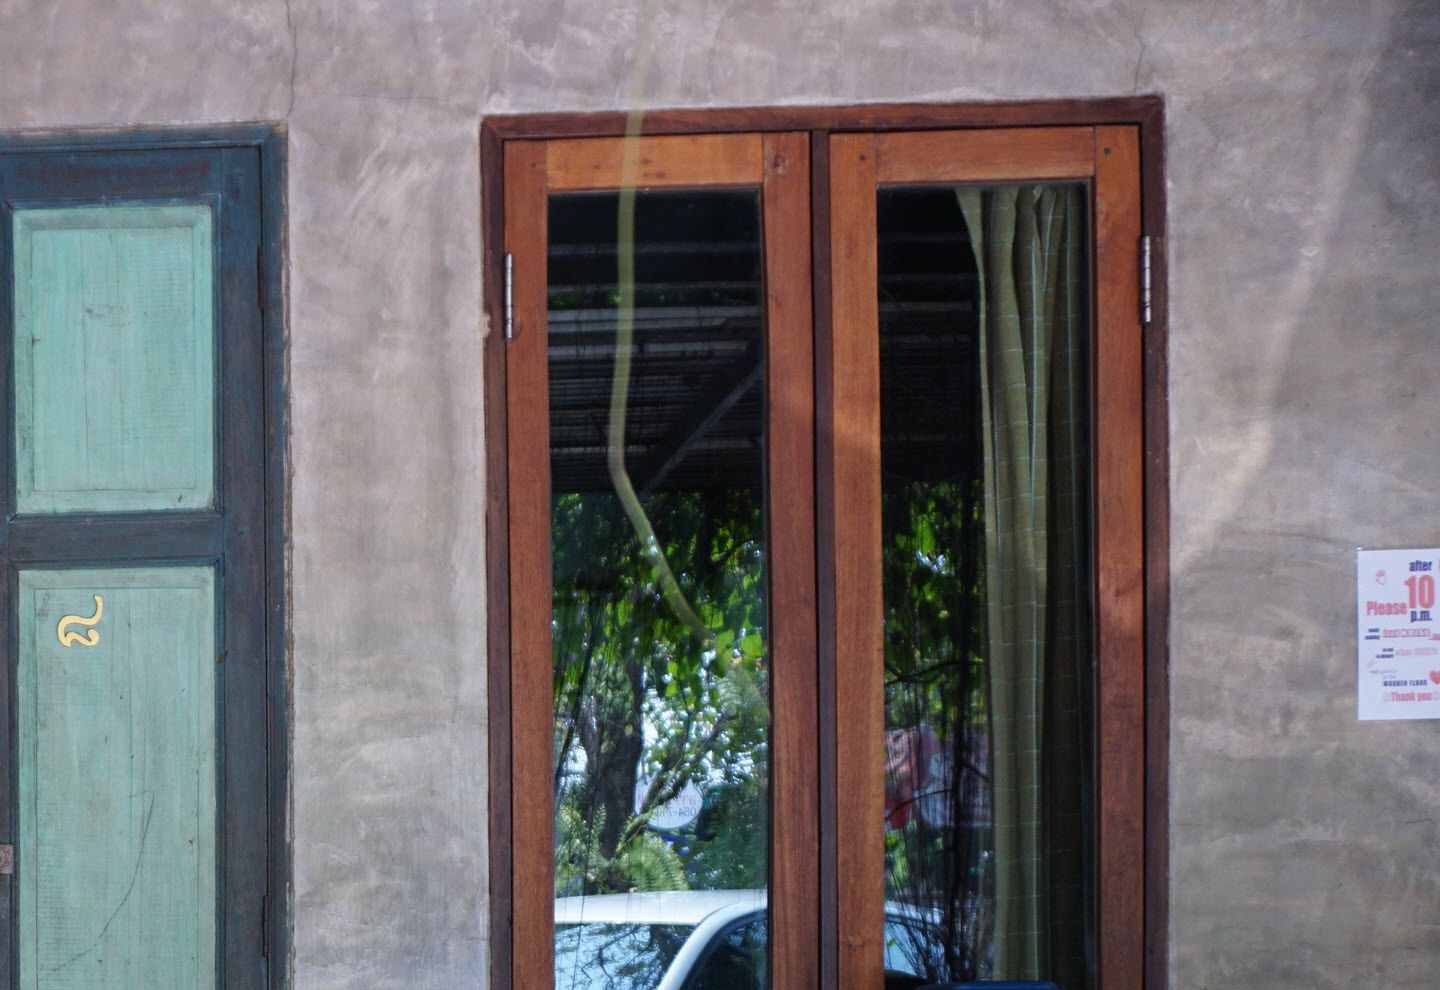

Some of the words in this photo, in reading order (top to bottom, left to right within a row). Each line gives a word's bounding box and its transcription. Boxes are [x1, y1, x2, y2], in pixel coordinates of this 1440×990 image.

[1409, 560, 1433, 573] after
[1403, 574, 1436, 609] 10
[1366, 600, 1408, 617] Please
[1410, 610, 1433, 624] p.m.
[1391, 691, 1416, 702] Thank
[1417, 692, 1433, 702] you
